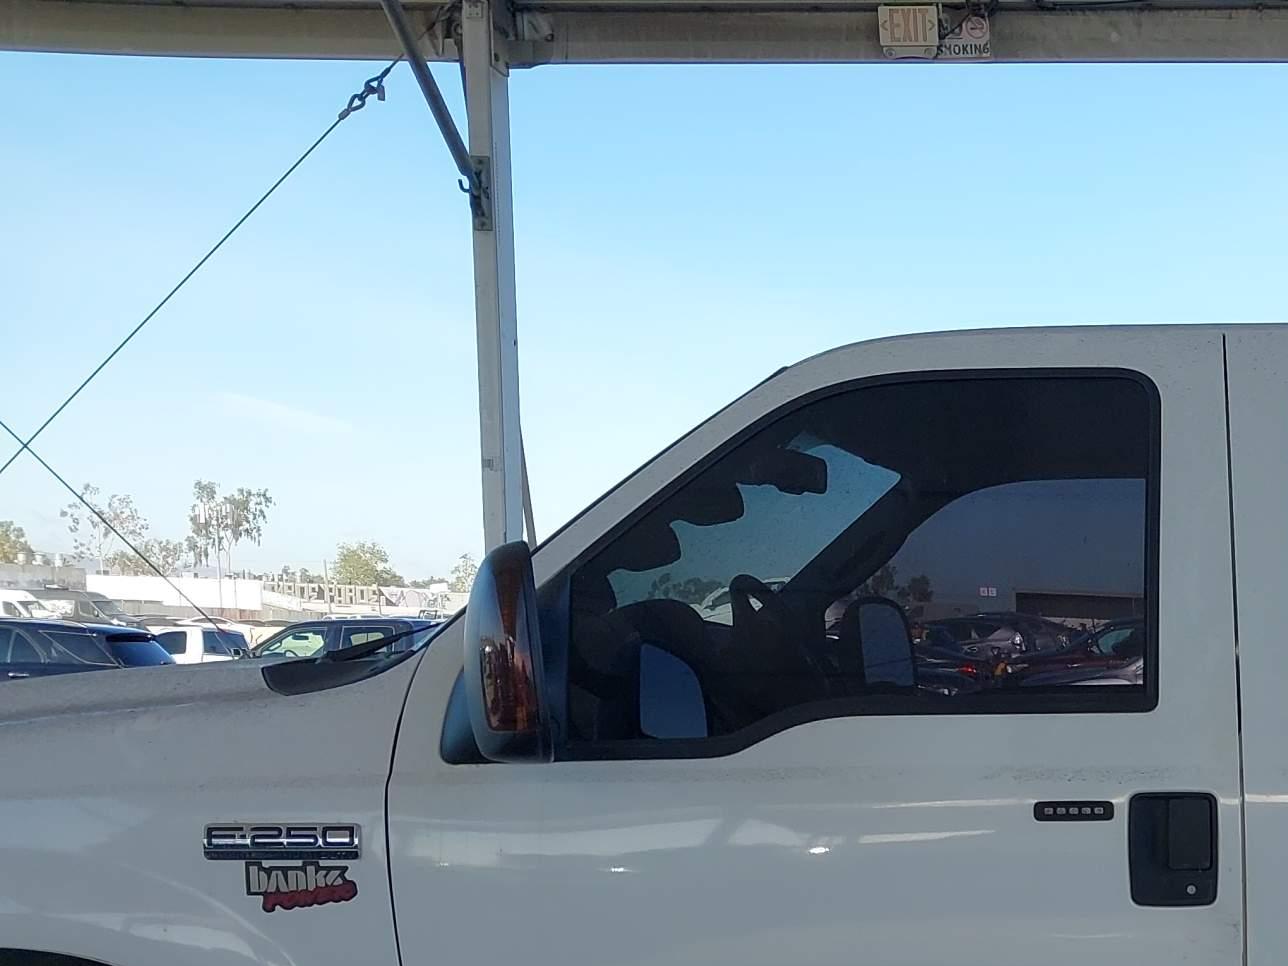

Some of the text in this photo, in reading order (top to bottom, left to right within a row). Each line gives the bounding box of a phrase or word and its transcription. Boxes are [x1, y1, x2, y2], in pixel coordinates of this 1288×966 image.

[888, 8, 929, 42] EXIT
[936, 42, 990, 56] SMOKING
[206, 825, 356, 848] F-250
